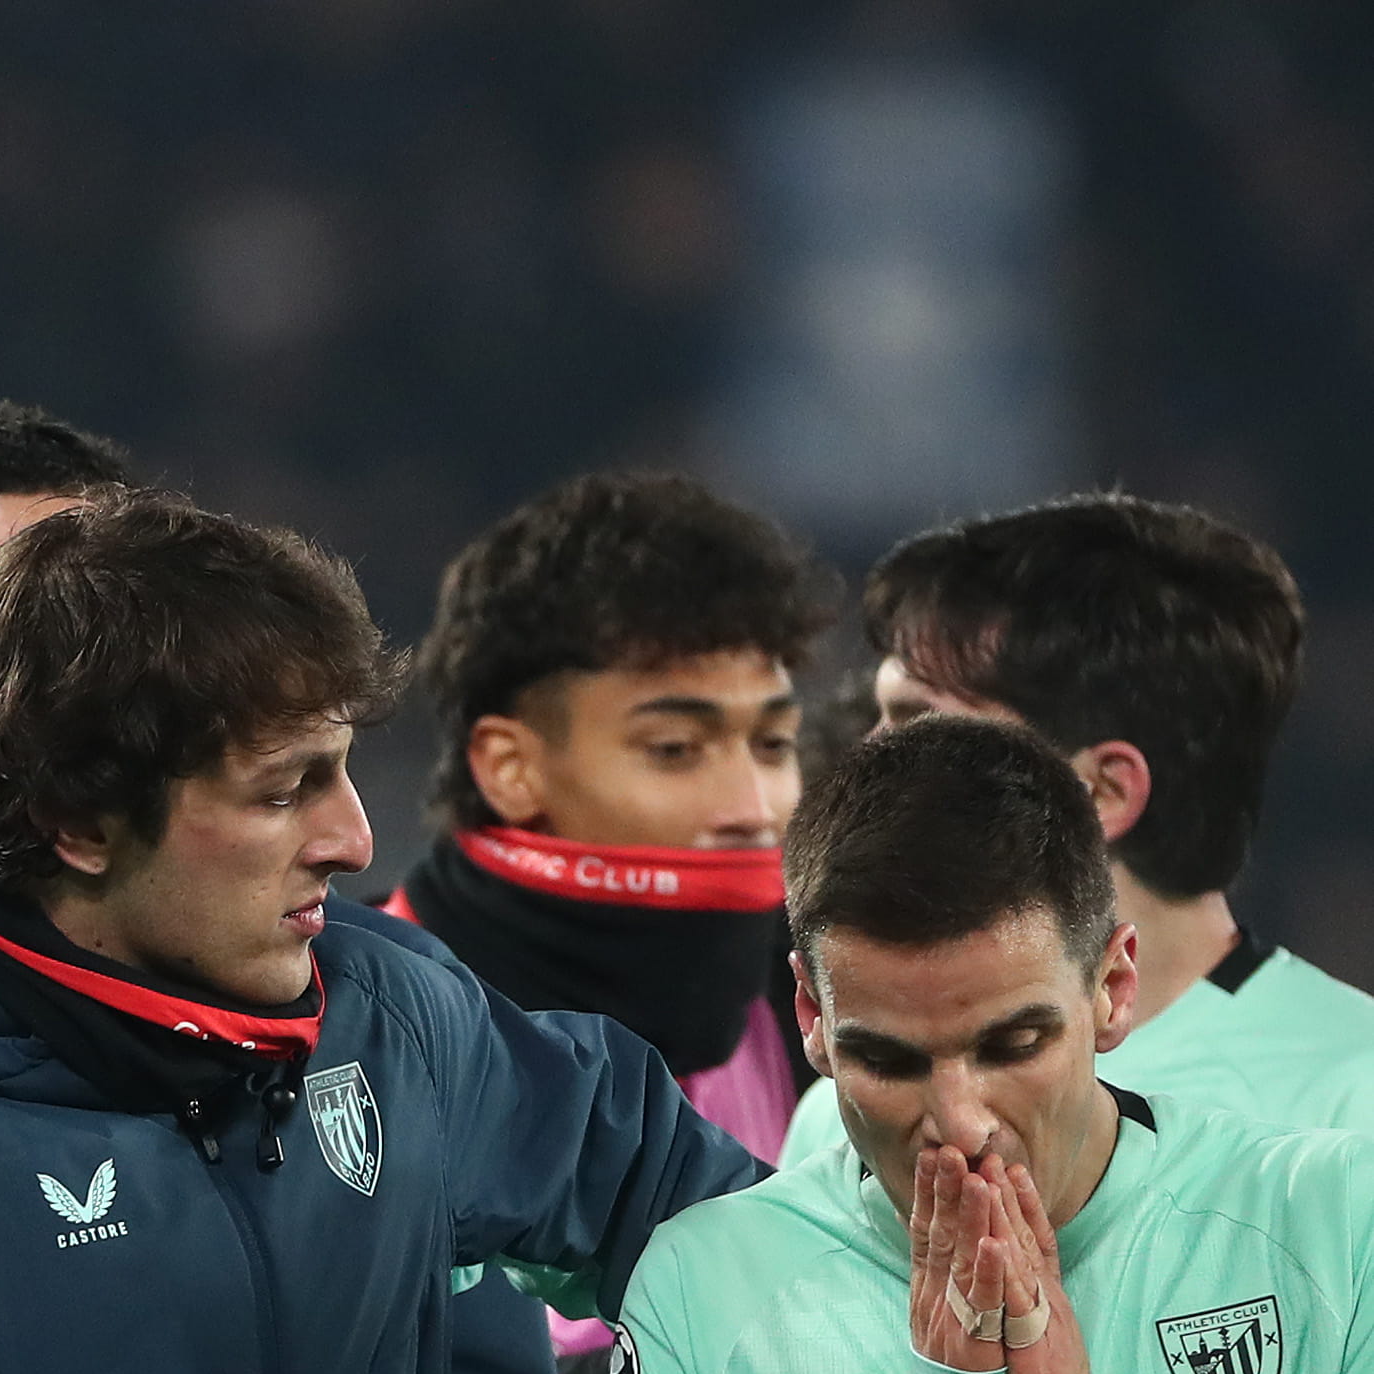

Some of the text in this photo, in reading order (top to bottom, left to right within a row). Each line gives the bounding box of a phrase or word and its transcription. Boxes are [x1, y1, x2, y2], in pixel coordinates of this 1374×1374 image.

[57, 1221, 128, 1249] CASTORE
[1167, 1303, 1269, 1334] ATHLETIC CLUB
